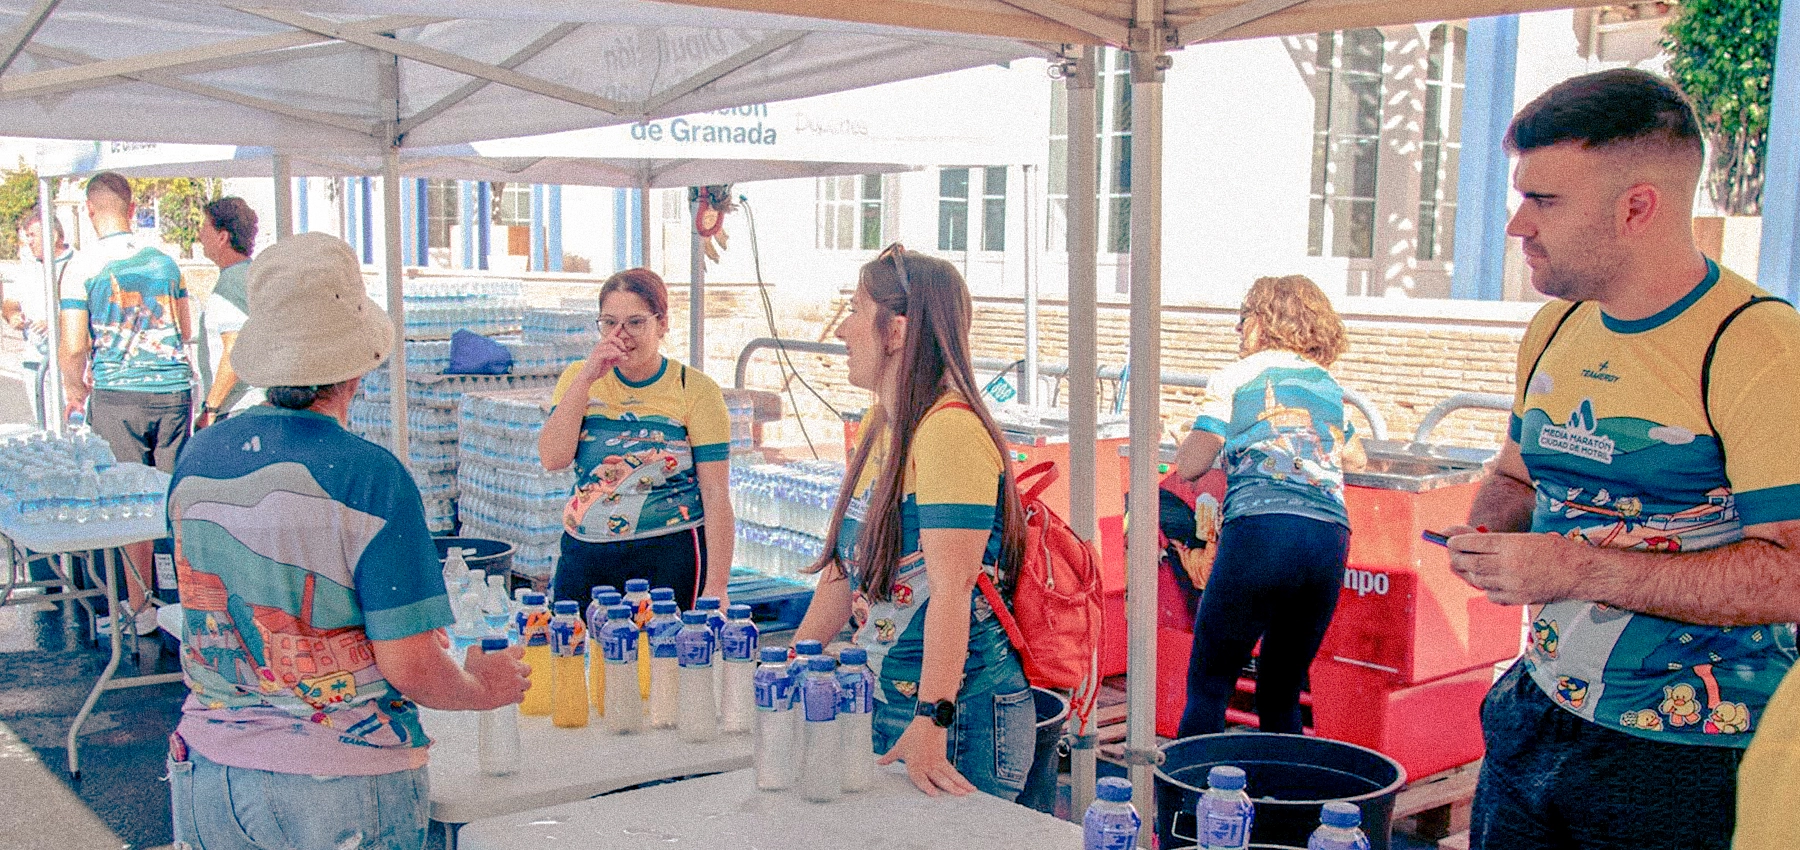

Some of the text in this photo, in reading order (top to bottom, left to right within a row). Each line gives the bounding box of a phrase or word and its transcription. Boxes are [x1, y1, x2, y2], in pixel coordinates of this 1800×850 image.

[630, 118, 777, 145] de Granada
[1543, 428, 1568, 440] MEDIA
[1541, 437, 1610, 461] CIUDAD DE MOTRIL
